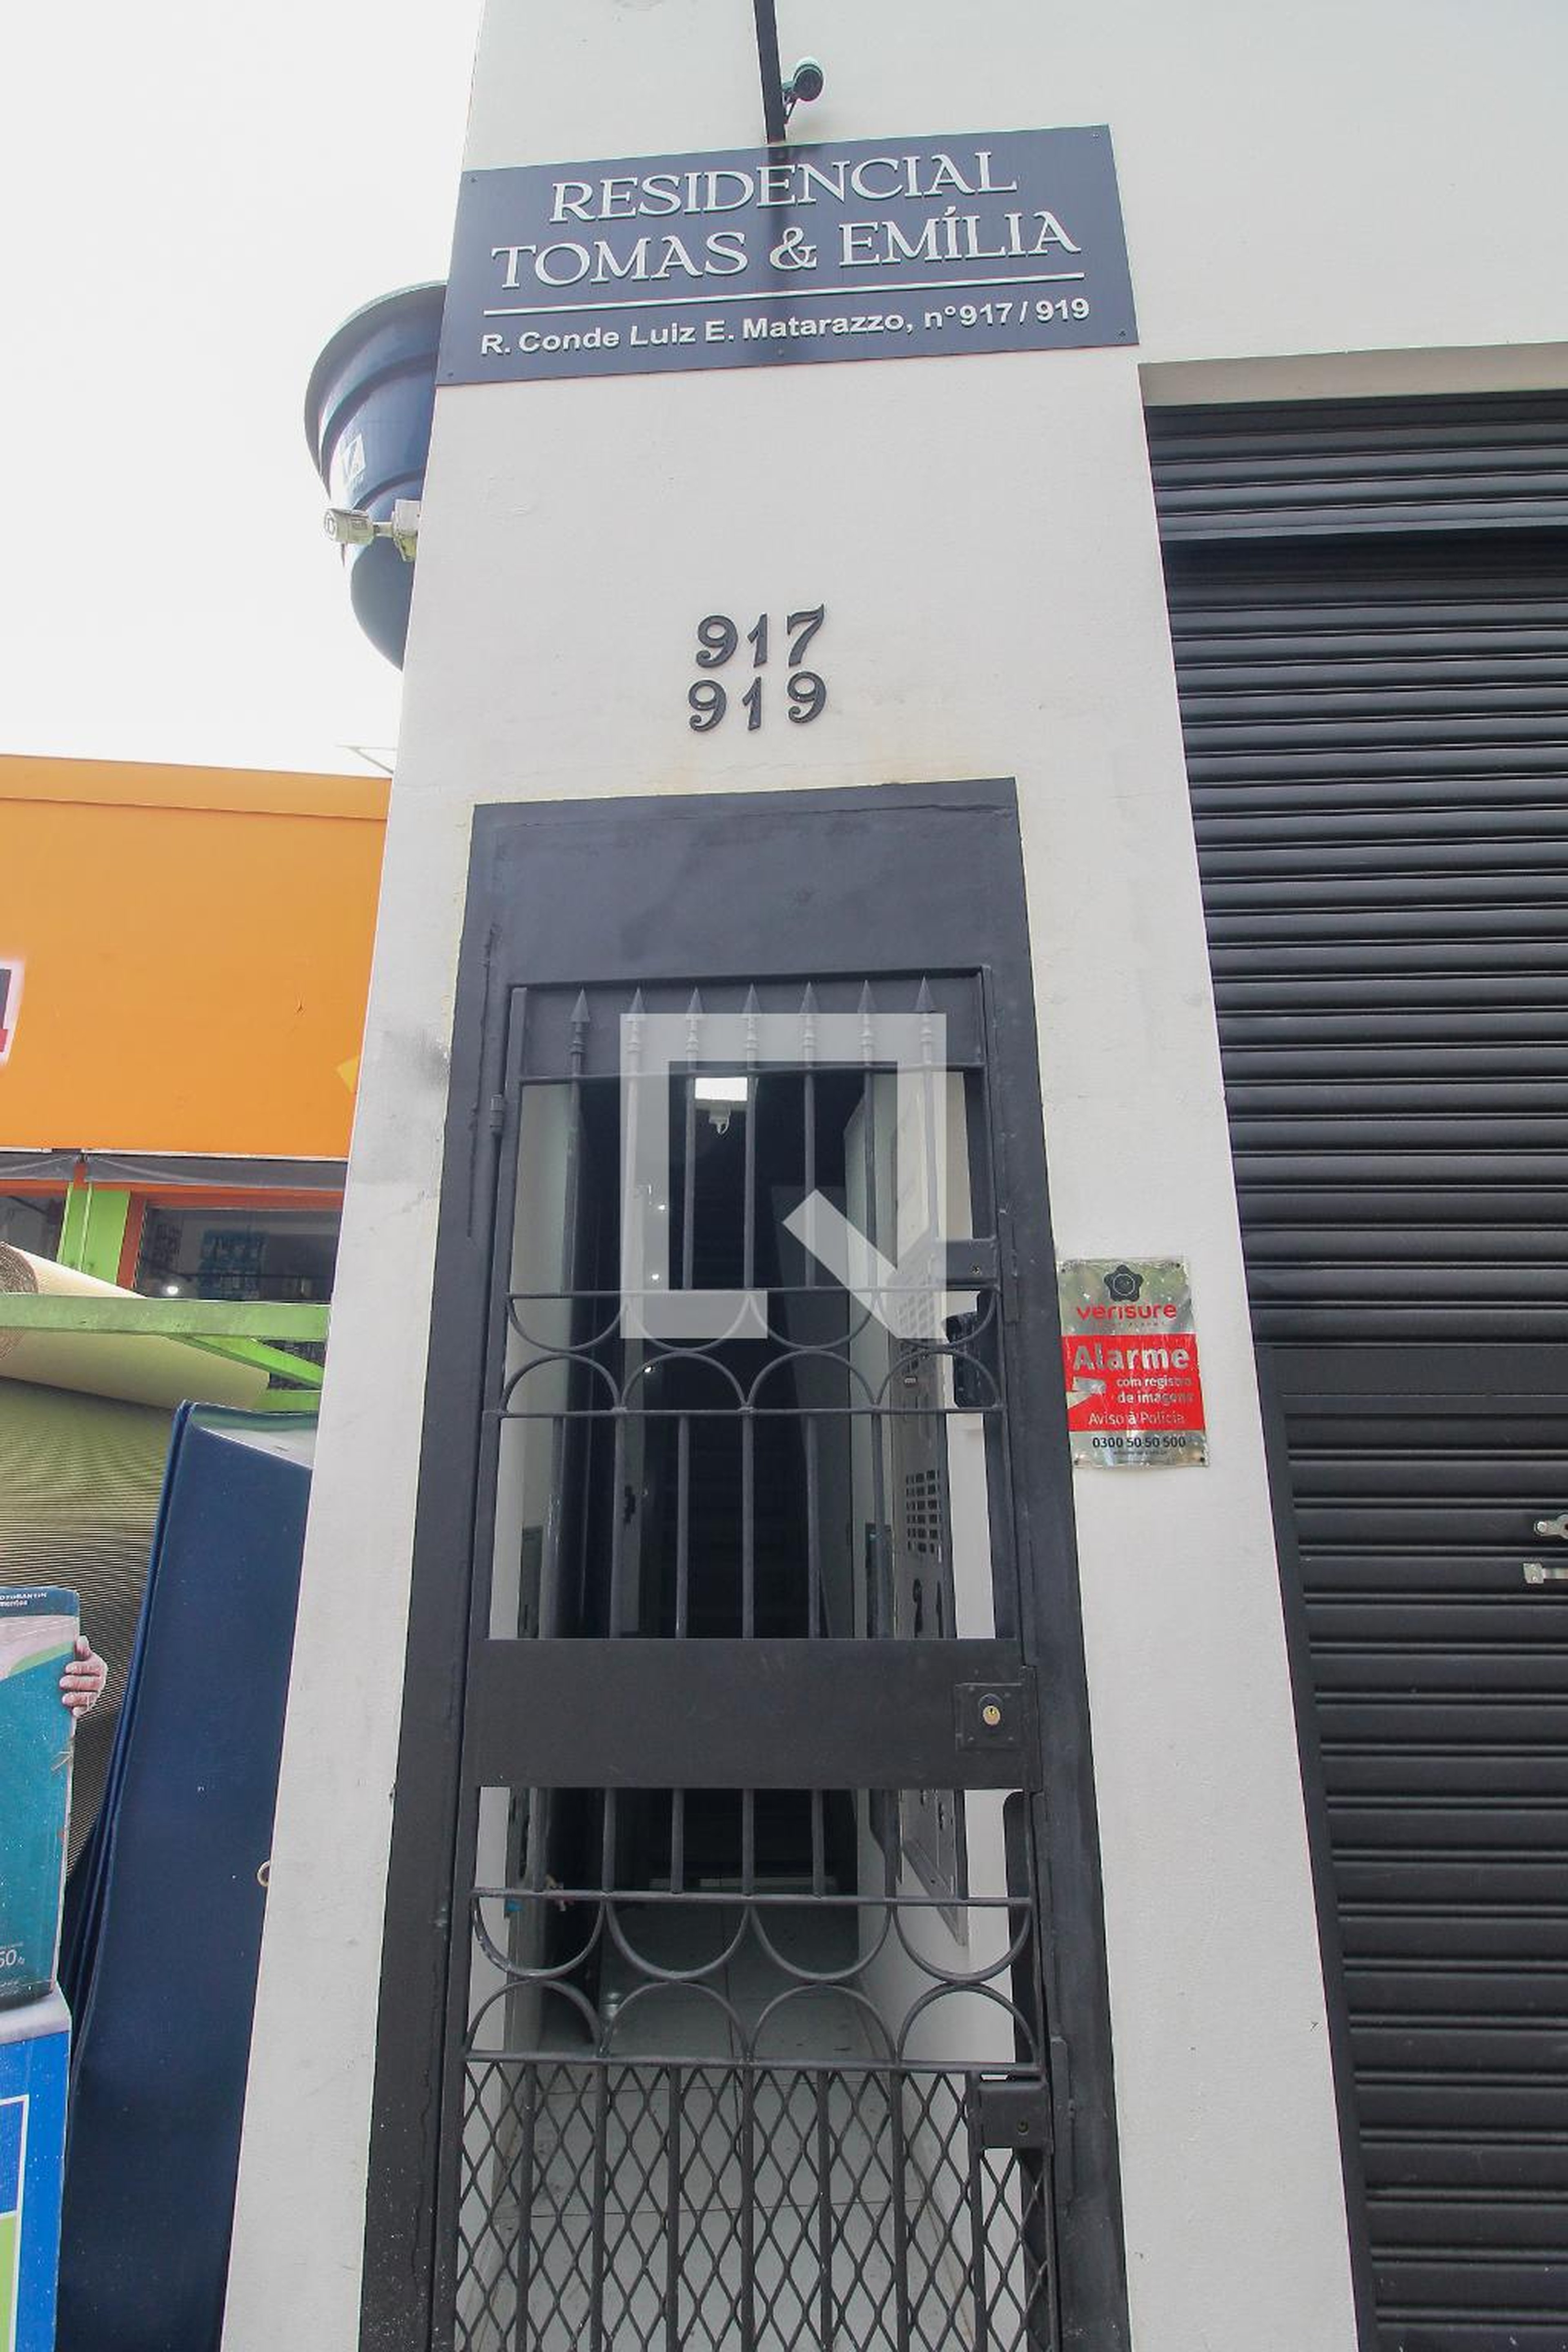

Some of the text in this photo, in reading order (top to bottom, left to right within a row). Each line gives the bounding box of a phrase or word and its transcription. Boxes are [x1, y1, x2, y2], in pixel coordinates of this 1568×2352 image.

[549, 151, 1017, 223] RESIDENCIAL
[491, 206, 1081, 289] TOMAS & EMÍLIA
[481, 334, 510, 355] R.
[519, 327, 619, 353] Conde
[630, 322, 696, 347] Luiz
[705, 320, 734, 342] E.
[742, 313, 913, 340] Matarazzo,
[696, 604, 824, 668] 917
[688, 671, 826, 732] 919
[1077, 1303, 1177, 1321] verisure
[1074, 1344, 1189, 1370] Alarme
[1116, 1378, 1142, 1387] com
[1117, 1392, 1134, 1403] de
[1088, 1412, 1123, 1425] Aviso
[1092, 1437, 1123, 1448] 0300
